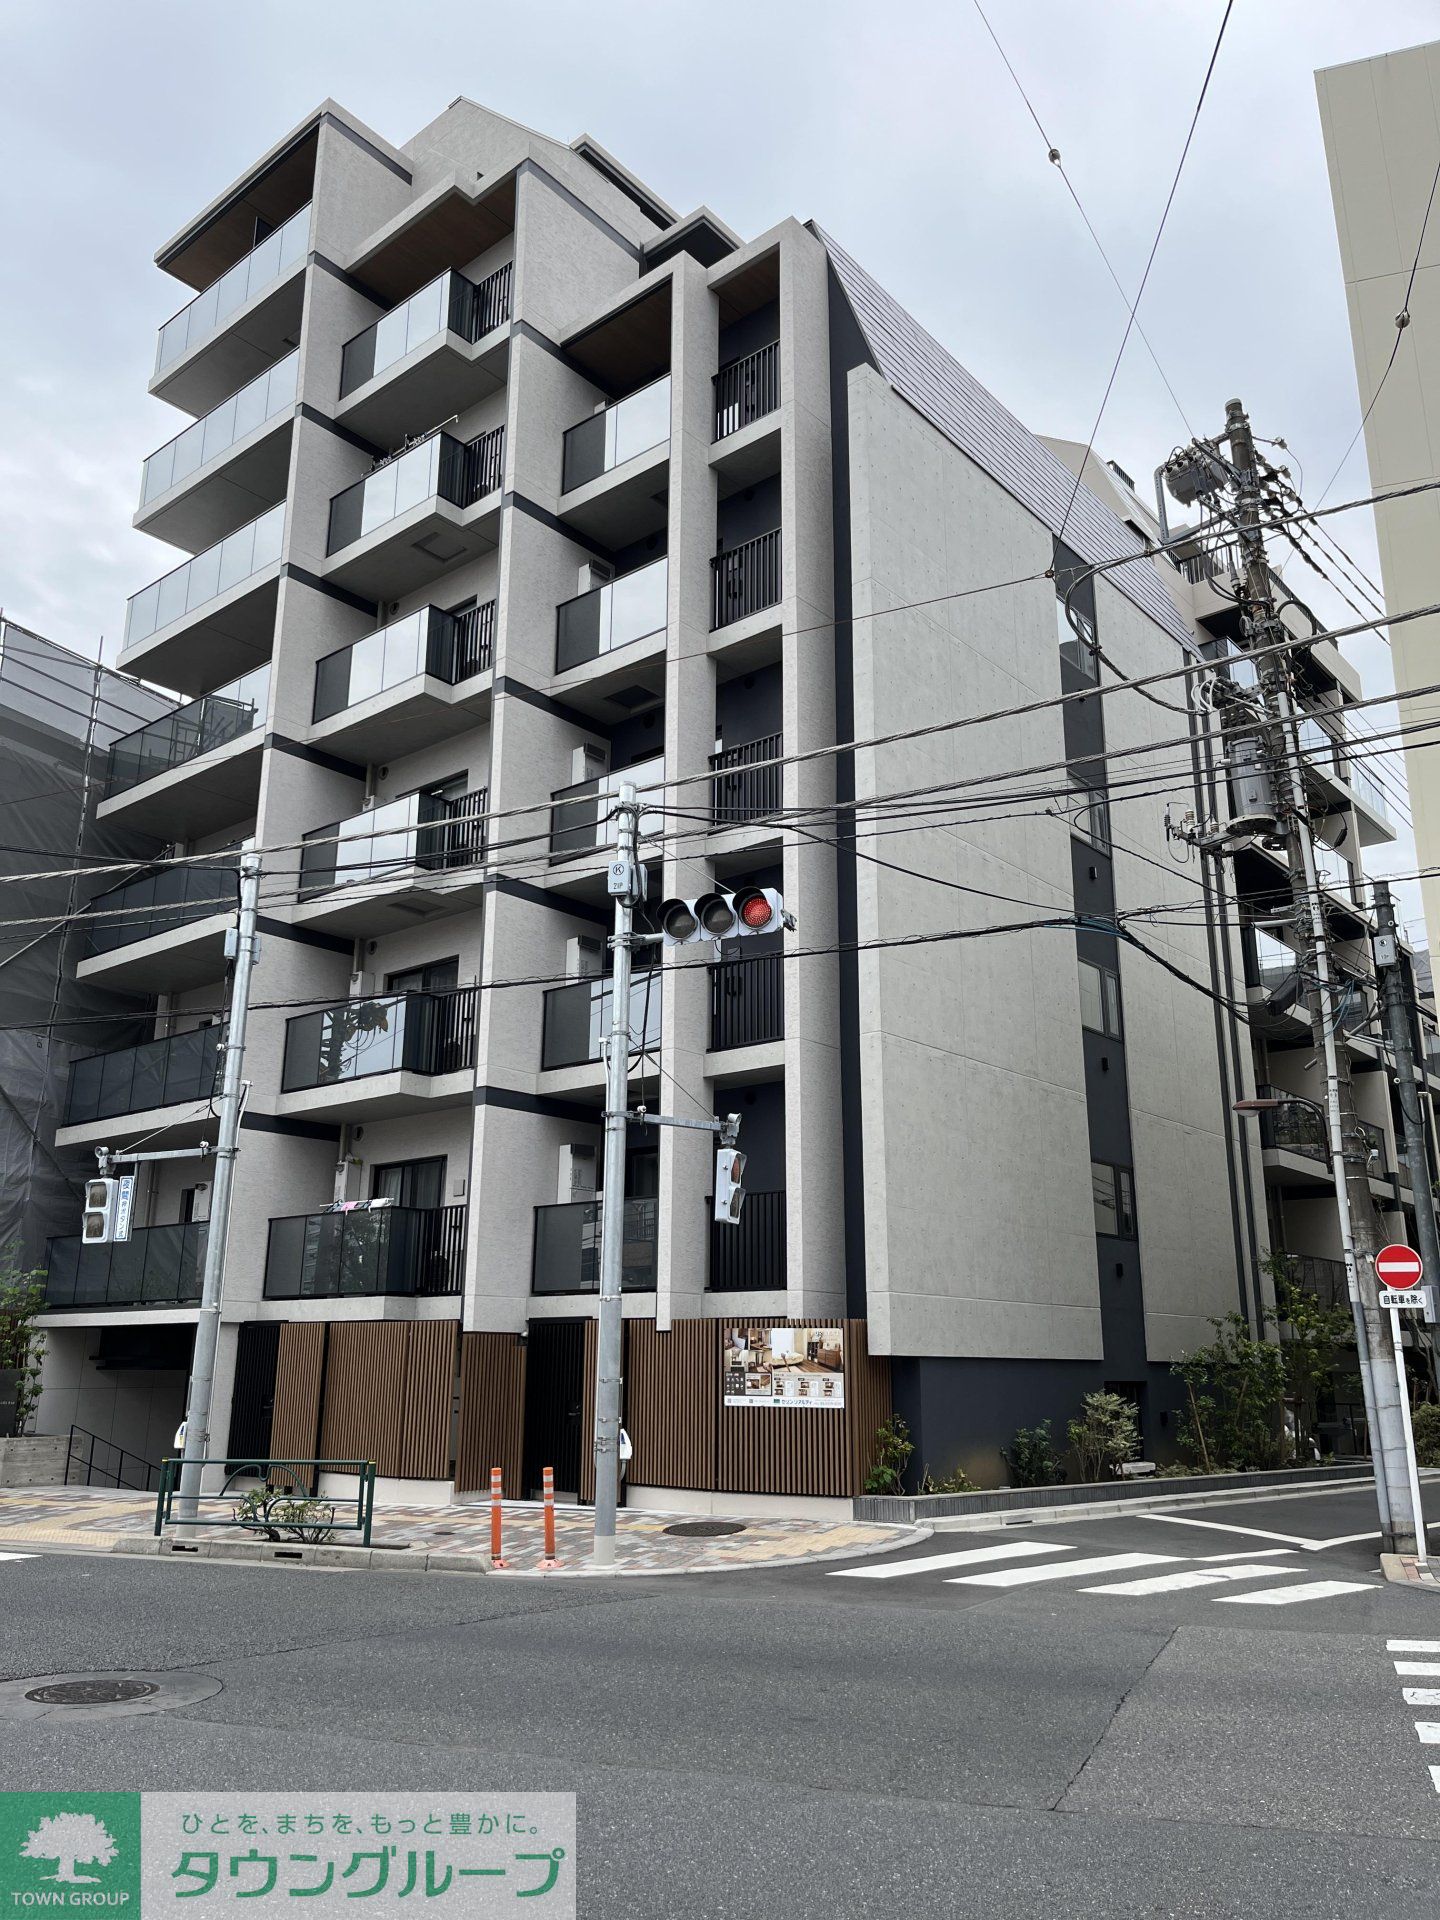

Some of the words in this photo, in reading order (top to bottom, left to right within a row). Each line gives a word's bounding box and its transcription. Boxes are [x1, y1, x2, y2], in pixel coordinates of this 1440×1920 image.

[1383, 1295, 1423, 1304] 自転車を除く
